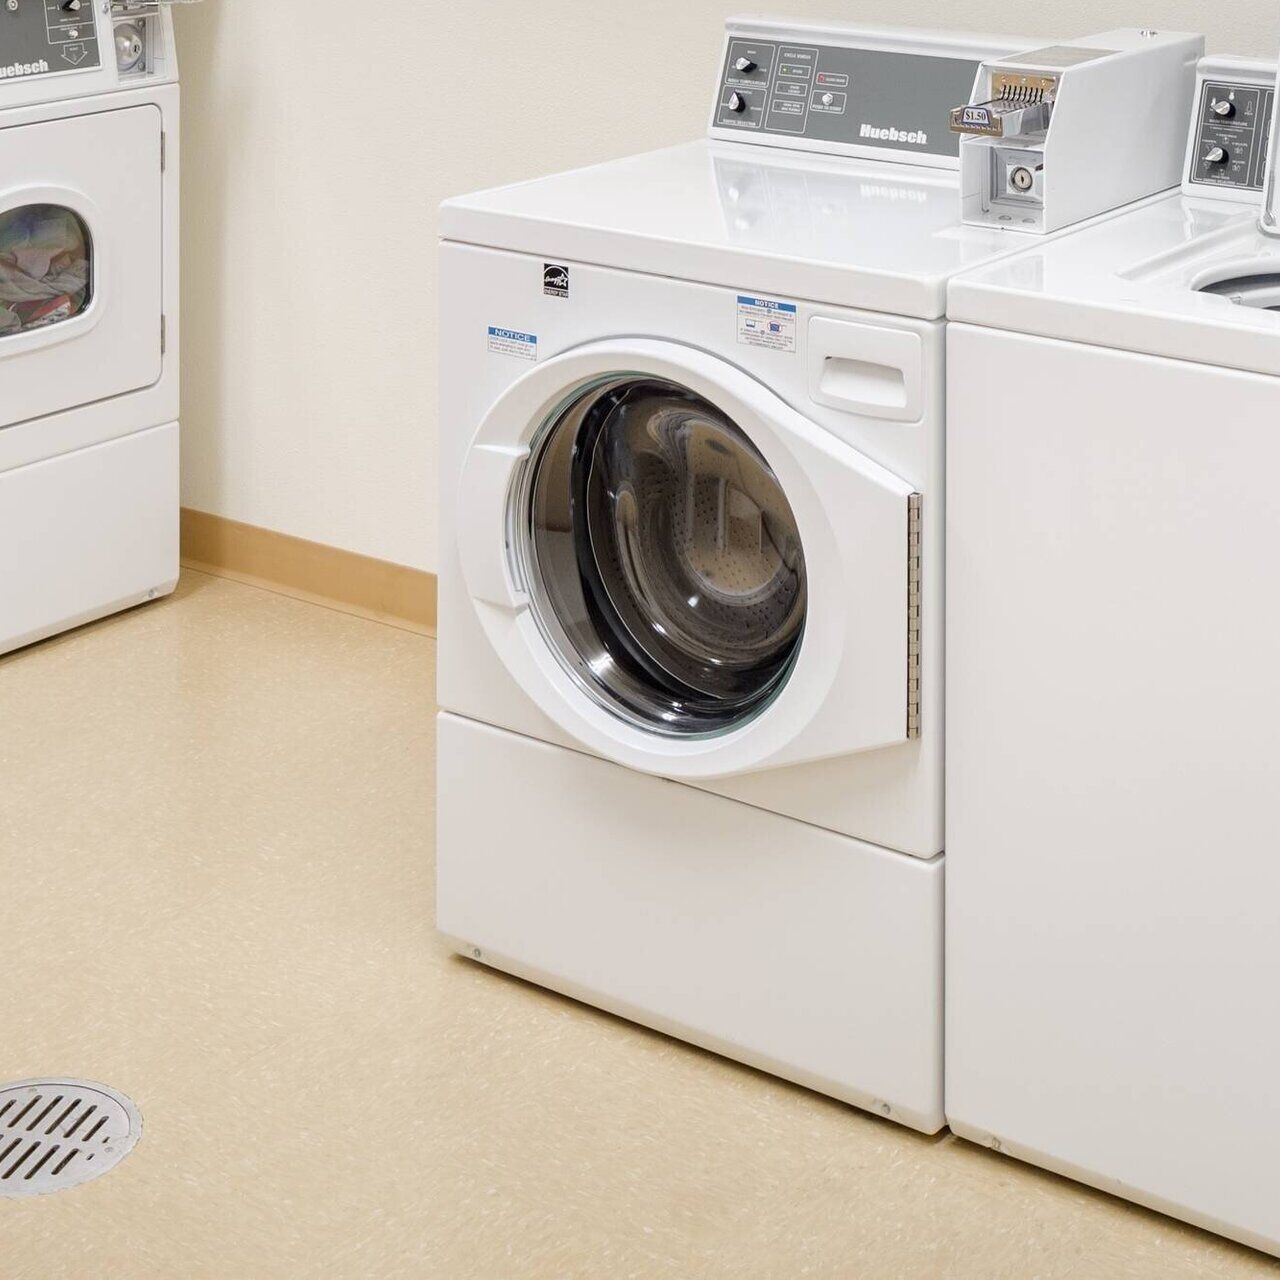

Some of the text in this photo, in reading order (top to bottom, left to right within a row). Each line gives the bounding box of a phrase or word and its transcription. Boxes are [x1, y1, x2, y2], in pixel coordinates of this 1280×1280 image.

[965, 111, 986, 121] $1.50
[859, 123, 928, 145] Huebsch
[754, 299, 779, 309] NOTICE
[494, 328, 532, 342] NOTICE
